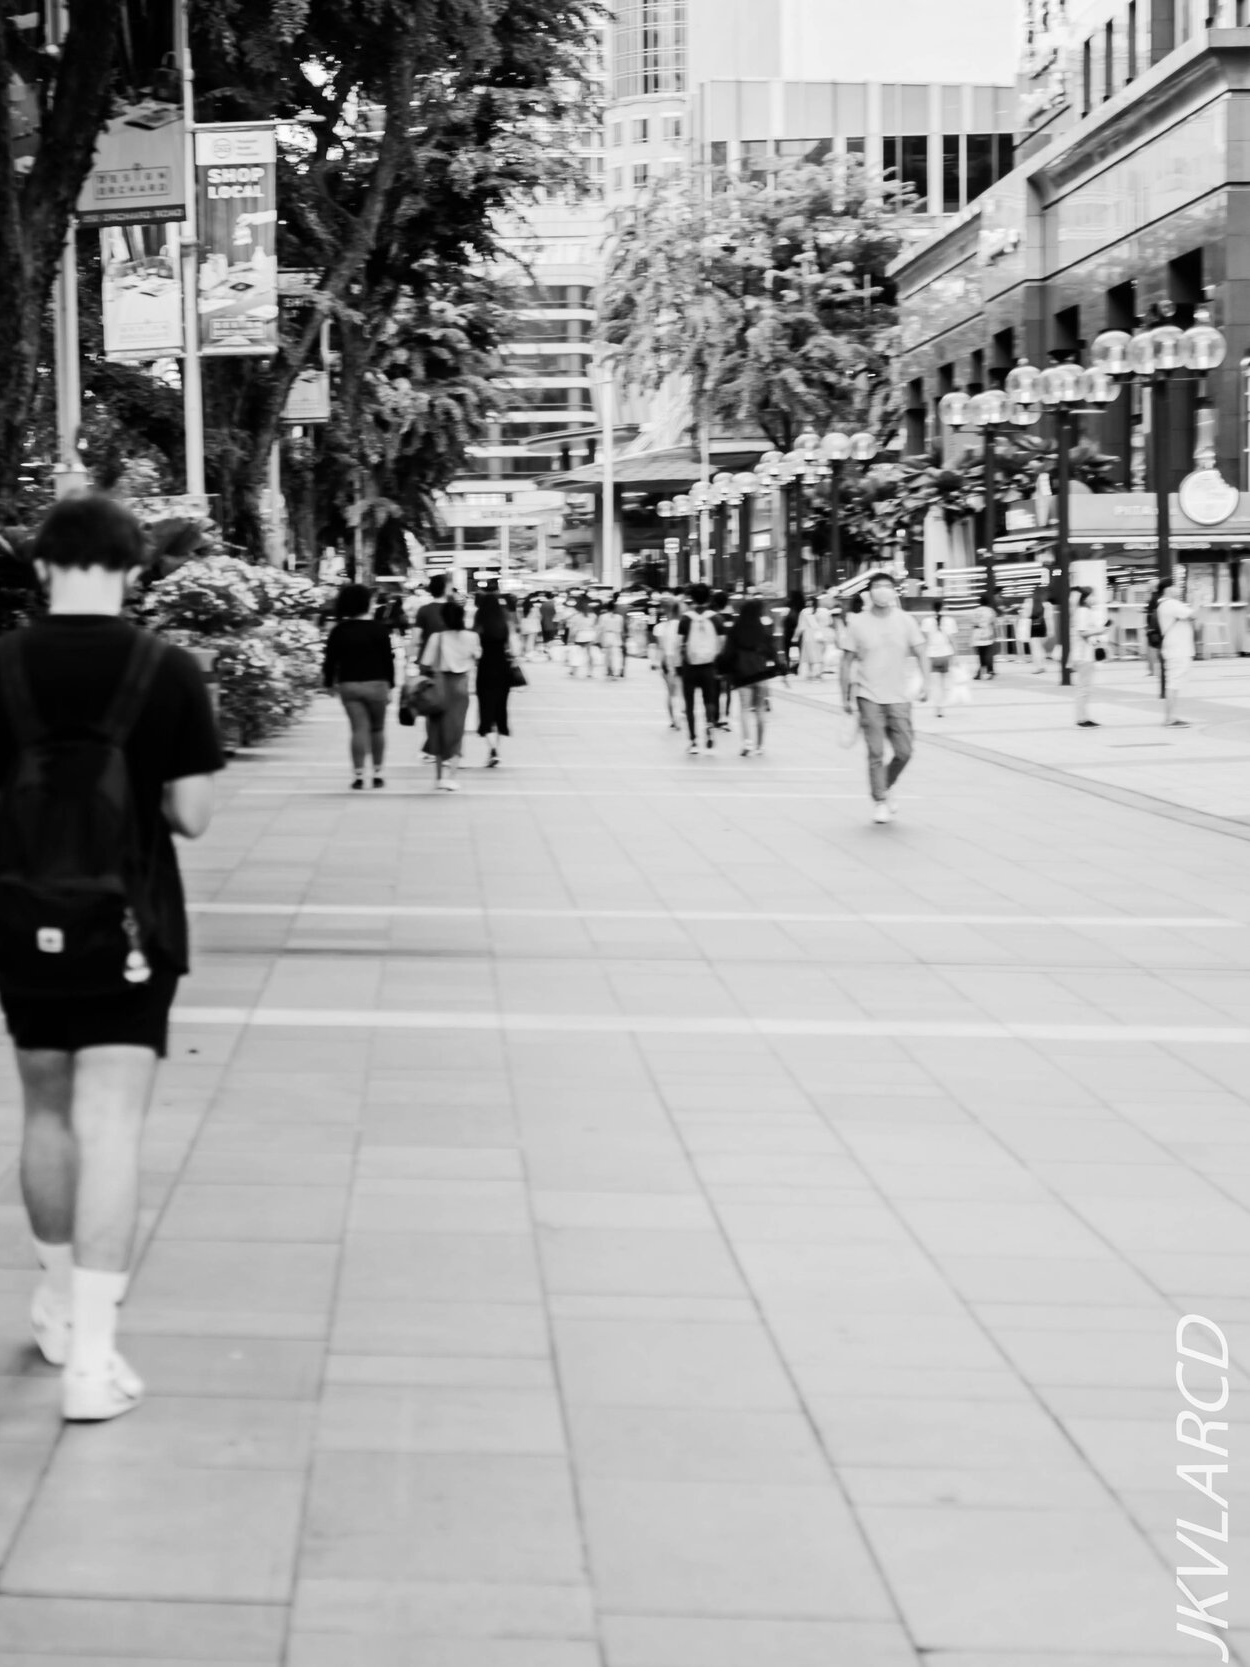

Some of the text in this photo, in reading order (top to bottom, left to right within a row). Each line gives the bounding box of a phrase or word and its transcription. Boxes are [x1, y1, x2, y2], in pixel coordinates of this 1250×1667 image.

[96, 171, 167, 184] DESIGN
[207, 167, 265, 183] SHOP
[96, 183, 167, 195] ORCHARD
[207, 185, 265, 198] LOCAL
